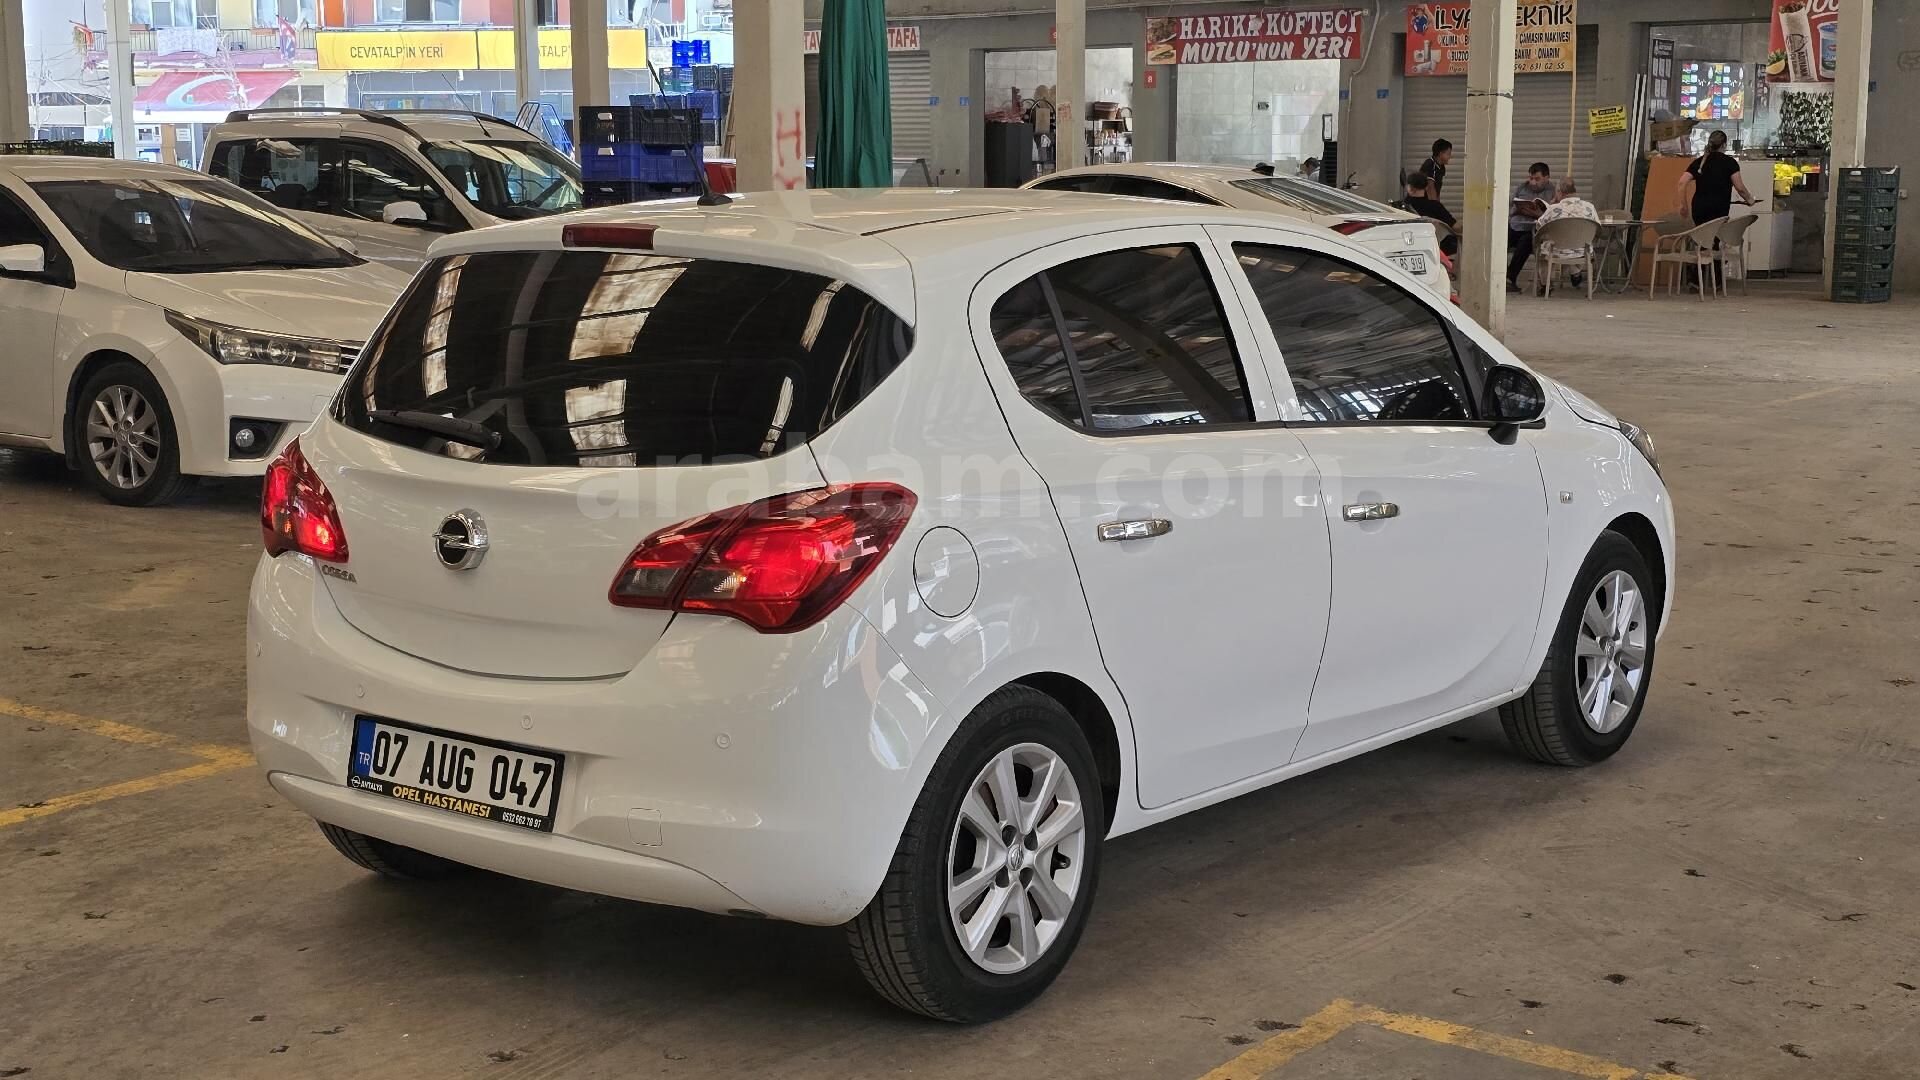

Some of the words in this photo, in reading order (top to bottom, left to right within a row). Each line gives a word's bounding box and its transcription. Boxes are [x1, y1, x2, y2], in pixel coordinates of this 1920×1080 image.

[418, 43, 443, 58] YERİ
[1181, 41, 1294, 64] MUTLU'NUN
[1301, 36, 1353, 59] YERİ
[359, 752, 370, 766] TR
[373, 731, 408, 777] 07
[419, 741, 475, 793] AUG
[488, 755, 552, 808] 047
[393, 786, 420, 802] OPEL
[424, 792, 491, 818] HASTANESİ
